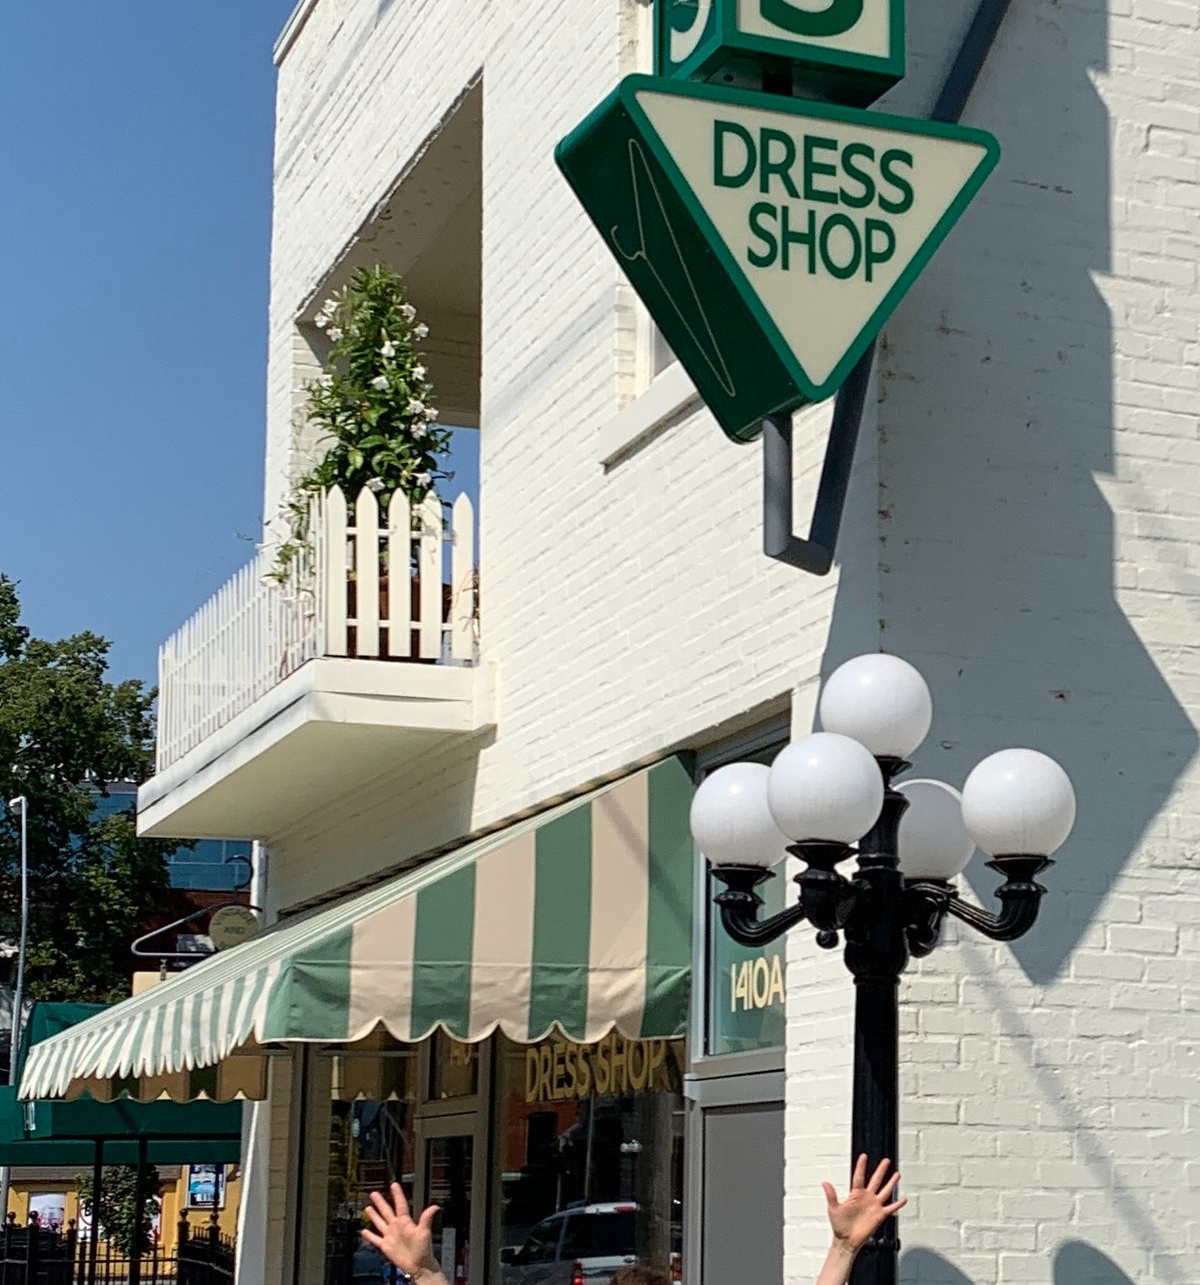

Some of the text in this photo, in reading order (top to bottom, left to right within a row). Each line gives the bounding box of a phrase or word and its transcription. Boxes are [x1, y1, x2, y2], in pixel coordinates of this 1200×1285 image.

[713, 120, 914, 214] DRESS
[746, 202, 897, 283] SHOP
[731, 954, 785, 1013] 1410A
[525, 1041, 591, 1103] DRESS
[594, 1034, 667, 1097] SHOP
